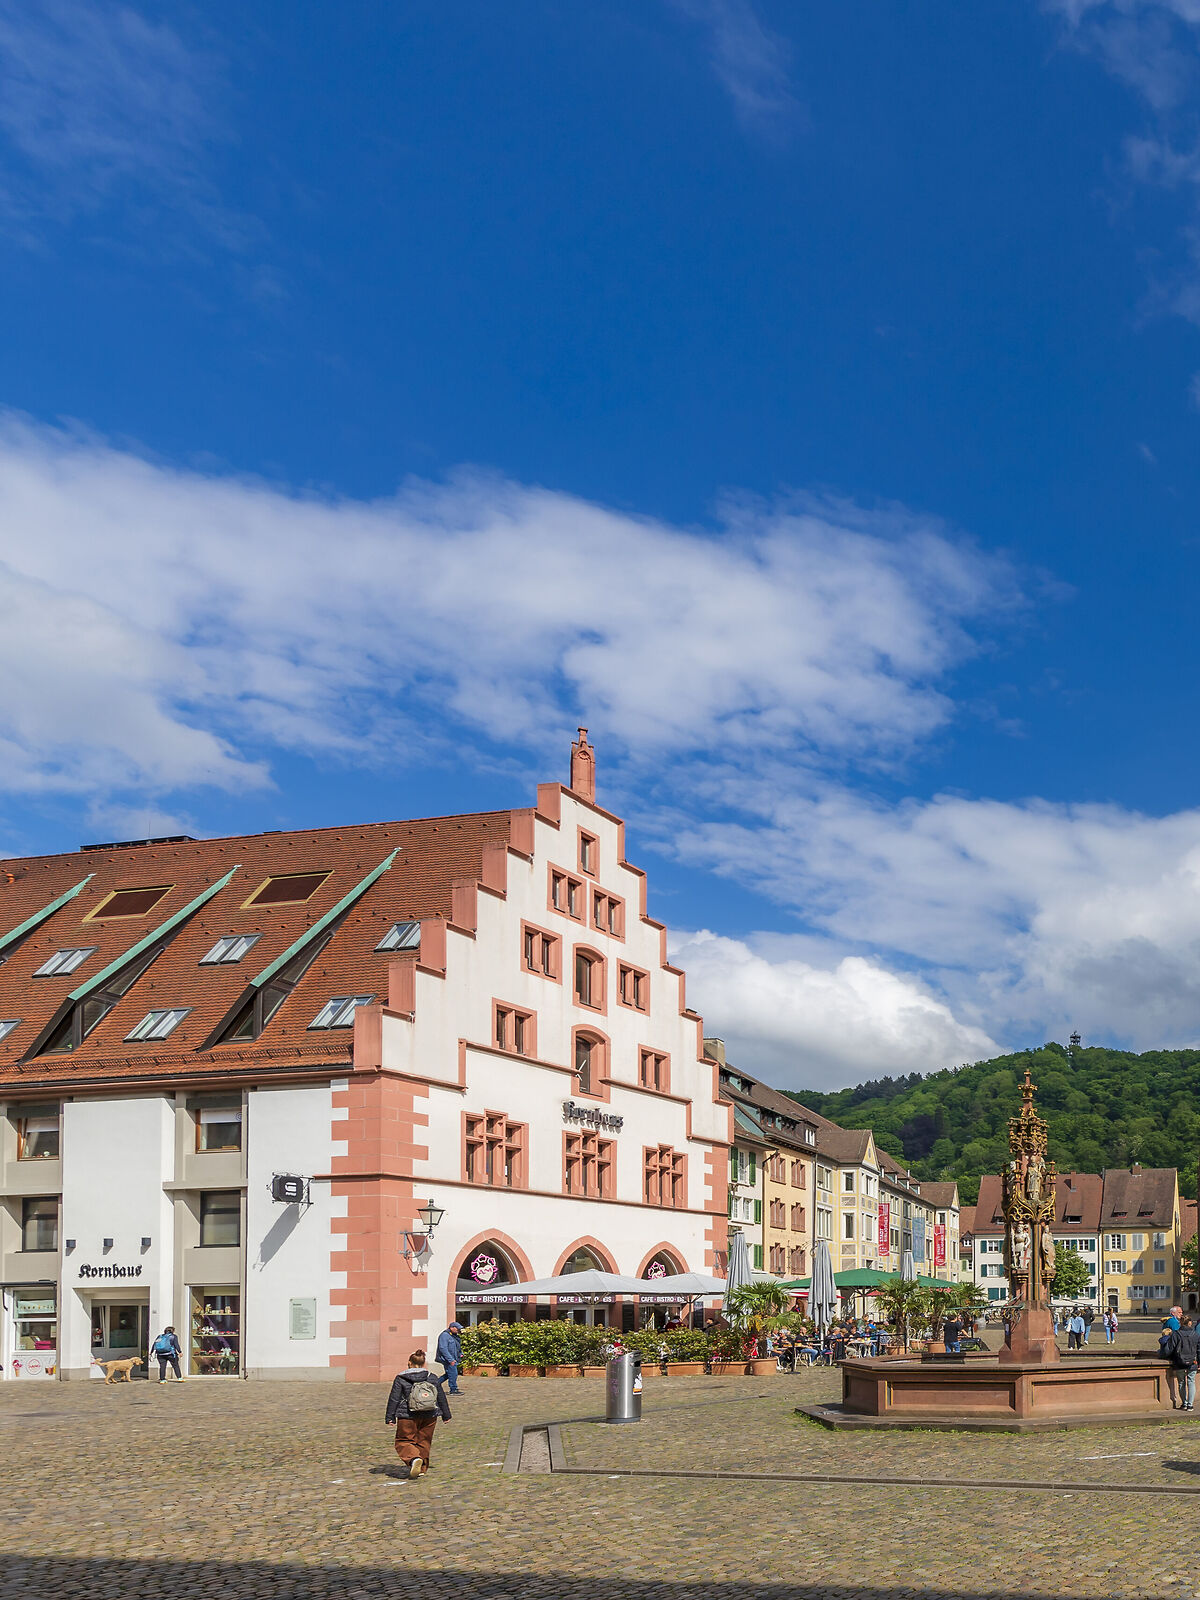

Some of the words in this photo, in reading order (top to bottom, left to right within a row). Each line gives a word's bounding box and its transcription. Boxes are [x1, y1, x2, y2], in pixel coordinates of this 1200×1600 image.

[562, 1101, 624, 1128] Kornhaus
[78, 1263, 143, 1279] Kornhaus
[458, 1295, 478, 1303] CAFE
[482, 1295, 508, 1303] BISTRO
